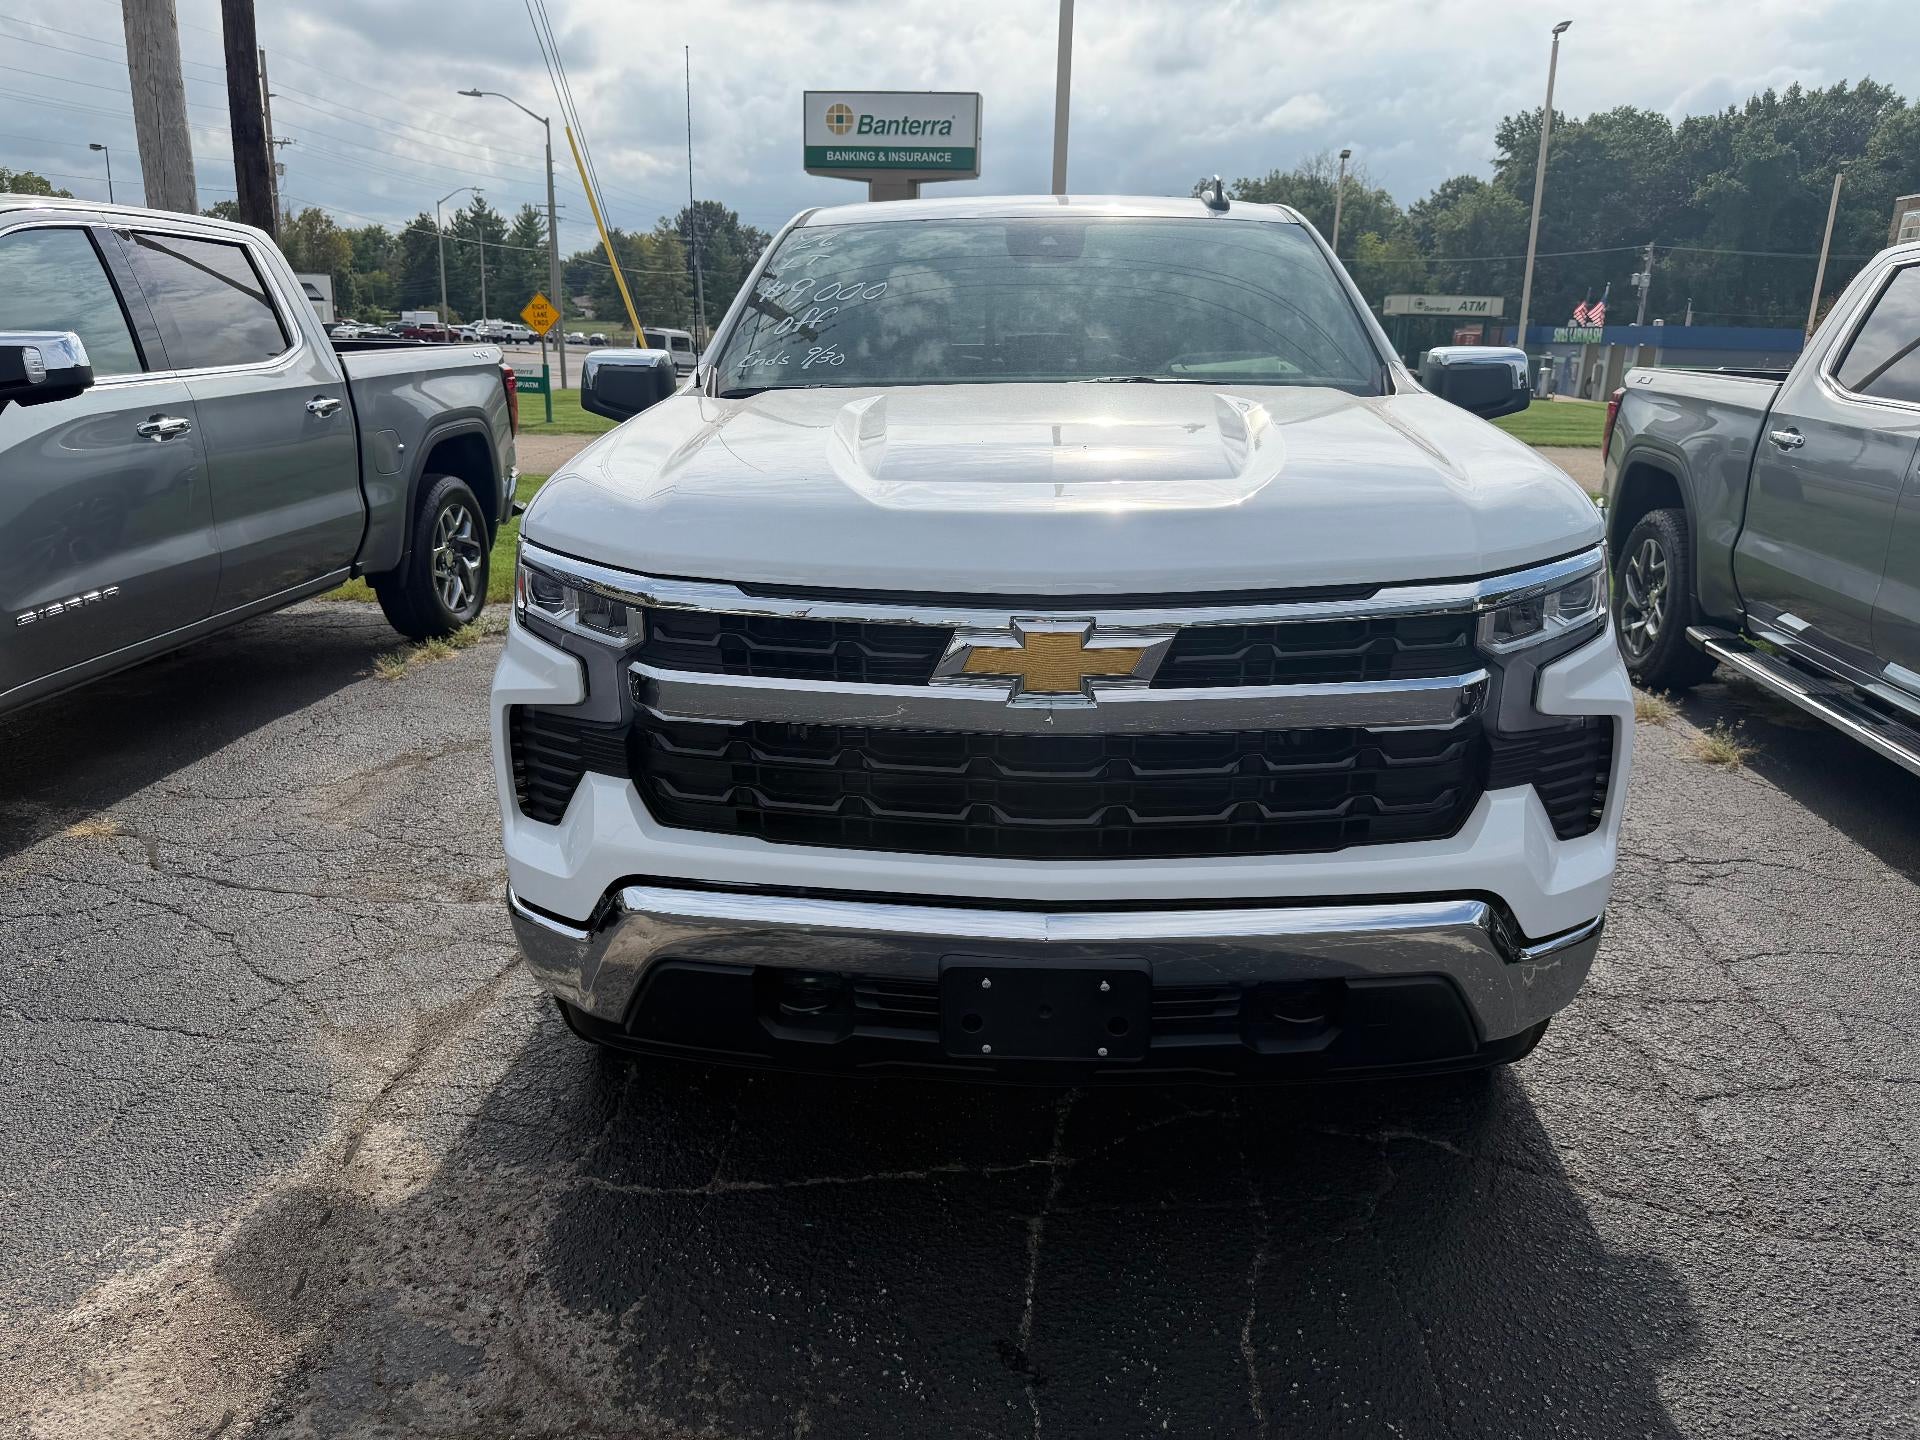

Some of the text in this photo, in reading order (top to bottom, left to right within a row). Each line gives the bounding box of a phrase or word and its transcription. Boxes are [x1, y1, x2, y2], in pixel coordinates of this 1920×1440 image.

[856, 114, 953, 136] Banterra
[826, 151, 952, 163] BANKING & INSURANCE
[1458, 301, 1488, 312] ATM
[533, 311, 548, 319] LANE
[533, 319, 549, 327] ENDS
[737, 343, 845, 370] Ends 9/30
[16, 586, 120, 627] SIERRA
